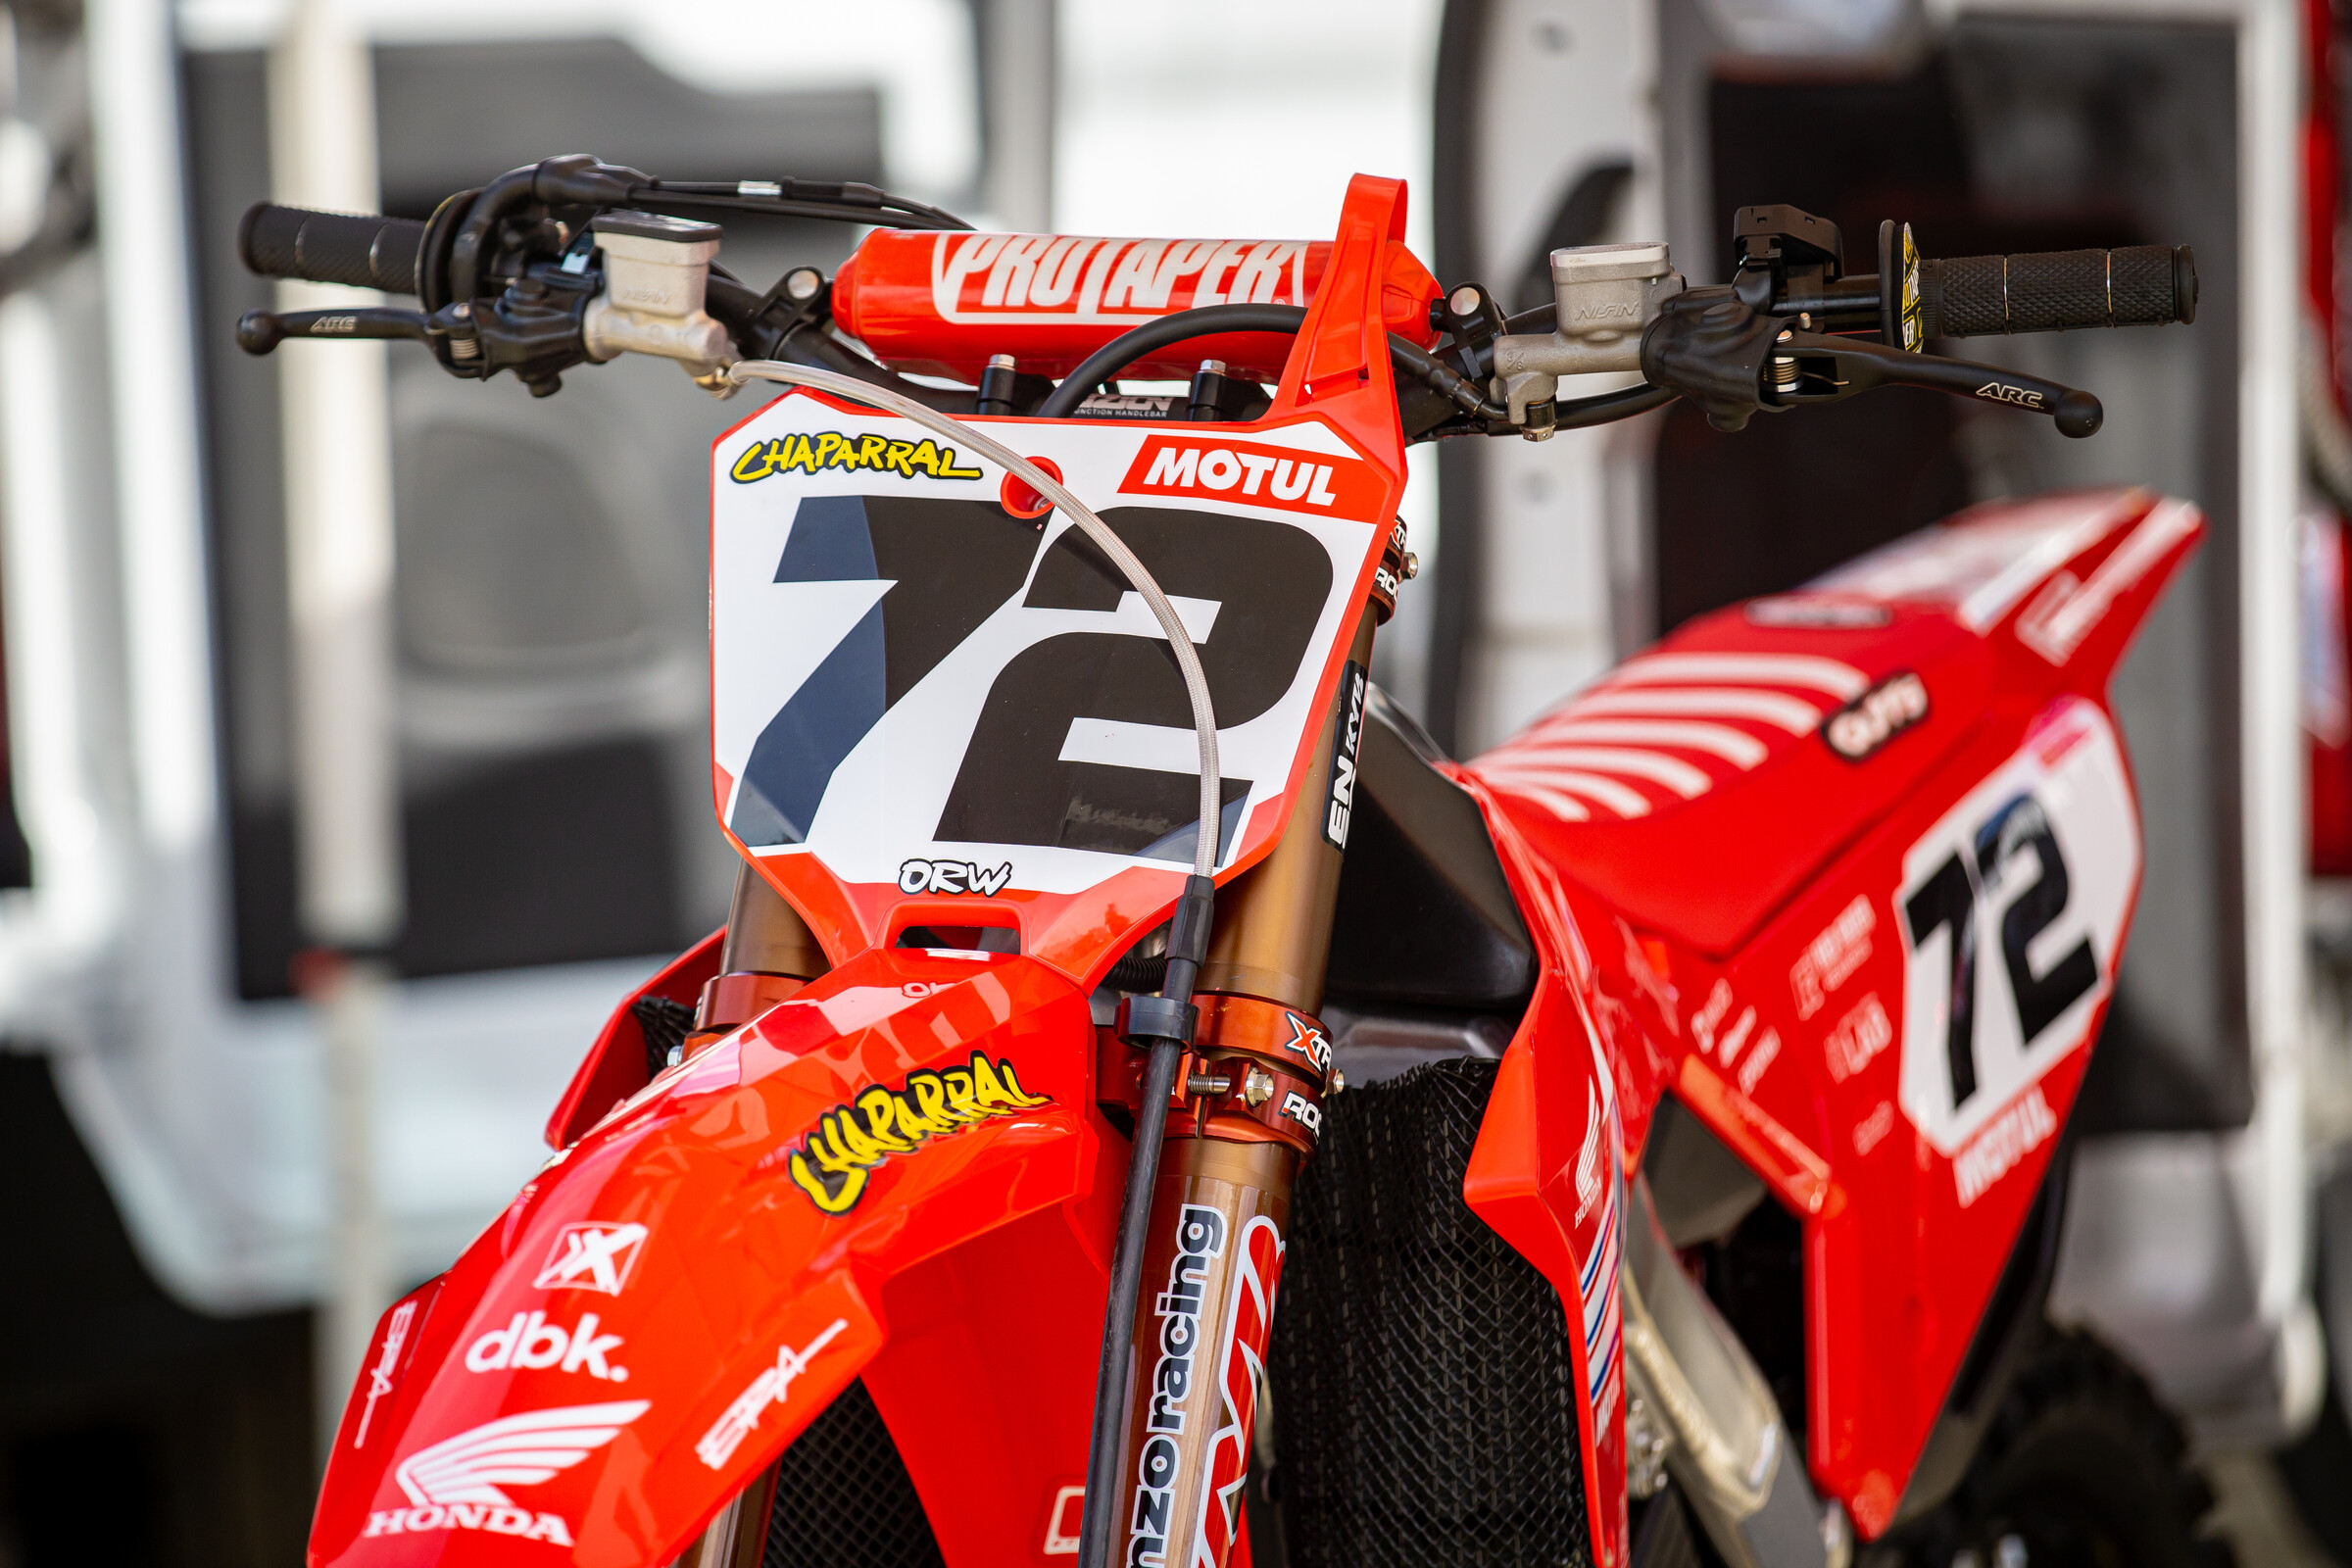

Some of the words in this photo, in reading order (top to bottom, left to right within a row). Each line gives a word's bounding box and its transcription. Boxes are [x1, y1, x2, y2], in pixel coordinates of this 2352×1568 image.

[936, 233, 1303, 321] PROTAPER
[310, 316, 358, 333] ARC
[1115, 409, 1168, 418] HANDLEBAR
[1976, 381, 2043, 409] ARC
[730, 431, 983, 482] CHAPARRAL
[1143, 447, 1337, 507] MOTUL
[730, 494, 1334, 868] 72
[899, 858, 1012, 898] ORW
[1905, 795, 2098, 1112] 72
[790, 1052, 1053, 1215] CHAPARRAL
[363, 1503, 575, 1547] HONDA
